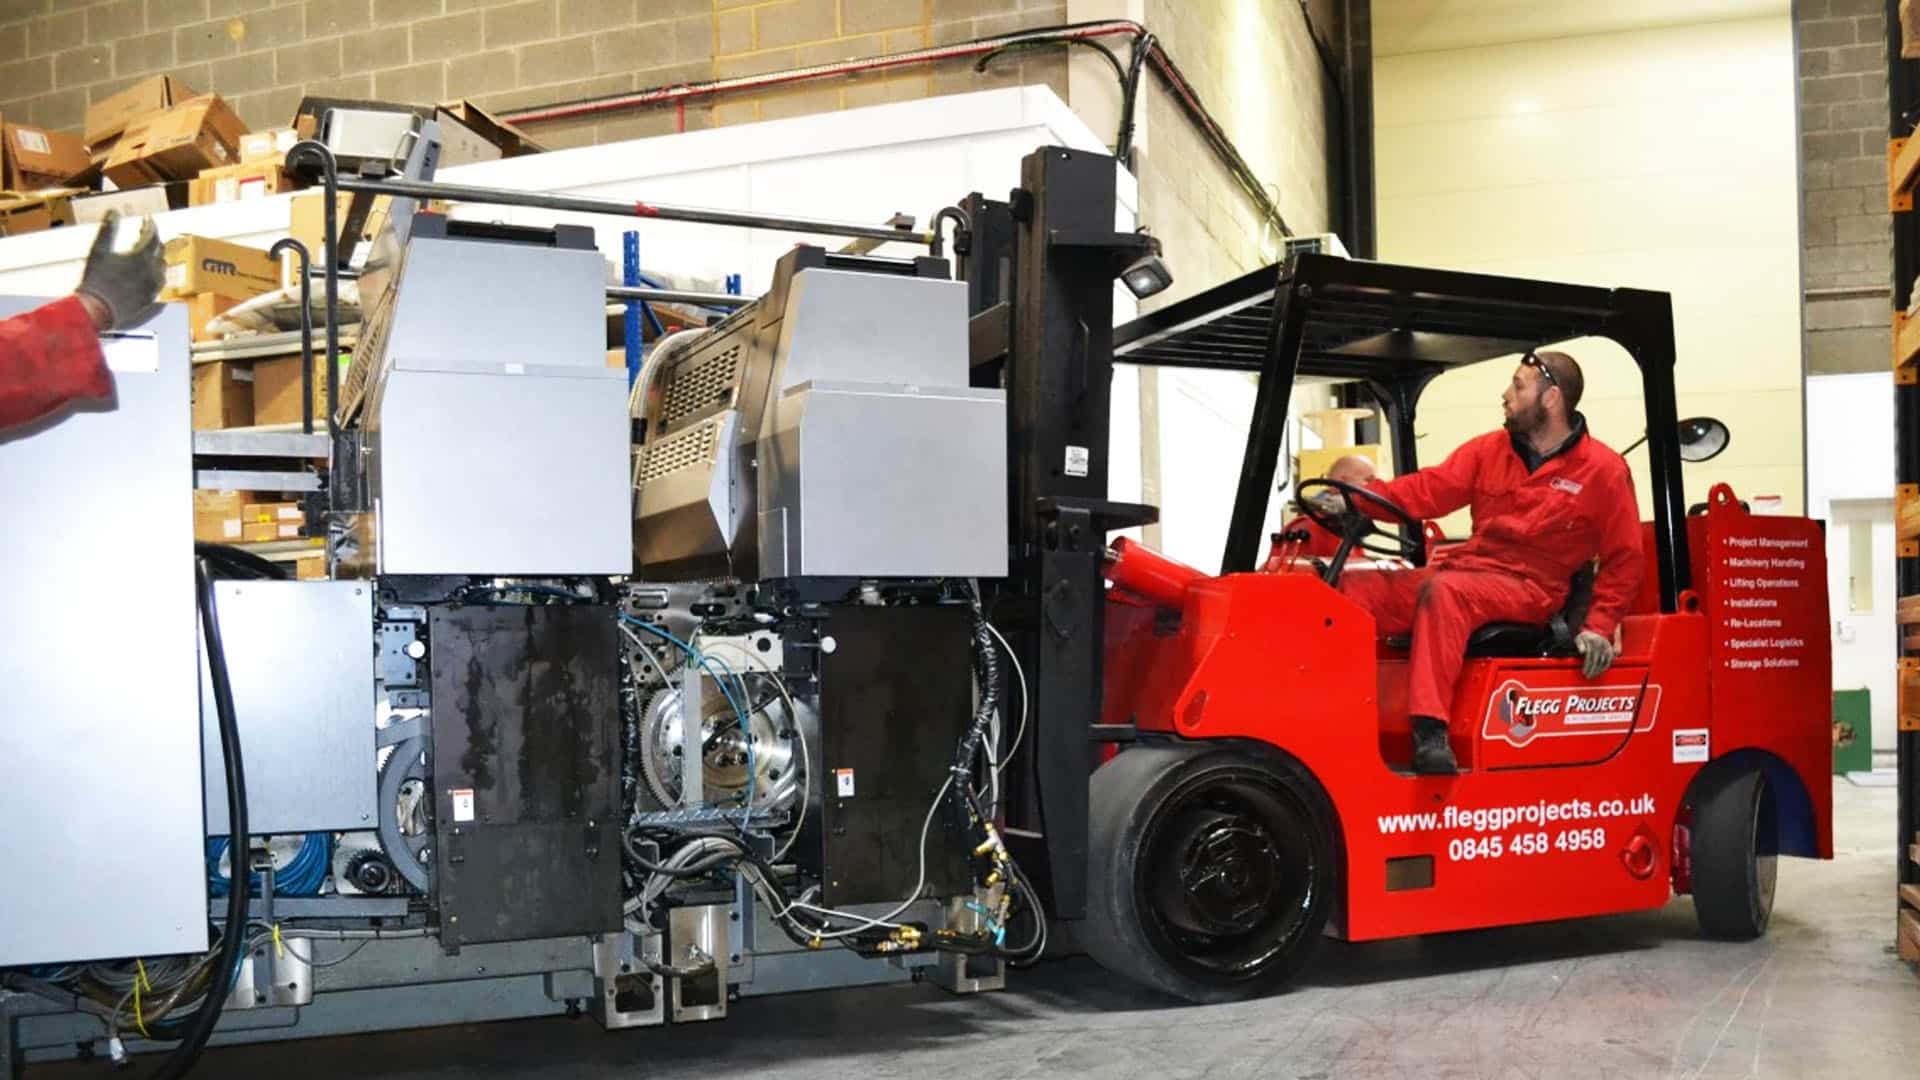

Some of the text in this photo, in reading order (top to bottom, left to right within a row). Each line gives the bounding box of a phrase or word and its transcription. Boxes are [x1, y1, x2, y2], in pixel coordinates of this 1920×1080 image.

[1728, 537, 1808, 549] Project Management
[1729, 557, 1805, 570] Machinery Handling
[1729, 578, 1799, 589] Lifting Operations
[1730, 598, 1777, 608] Installations
[1730, 618, 1782, 628] Re-Locations
[1730, 637, 1804, 650] Specialist Logistics
[1730, 657, 1799, 670] Storage Solutions
[1515, 694, 1636, 715] FLEGG PROJECTS
[1377, 793, 1656, 834] www.fleggprojects.co.uk
[1448, 827, 1606, 862] 0845 458 4958
